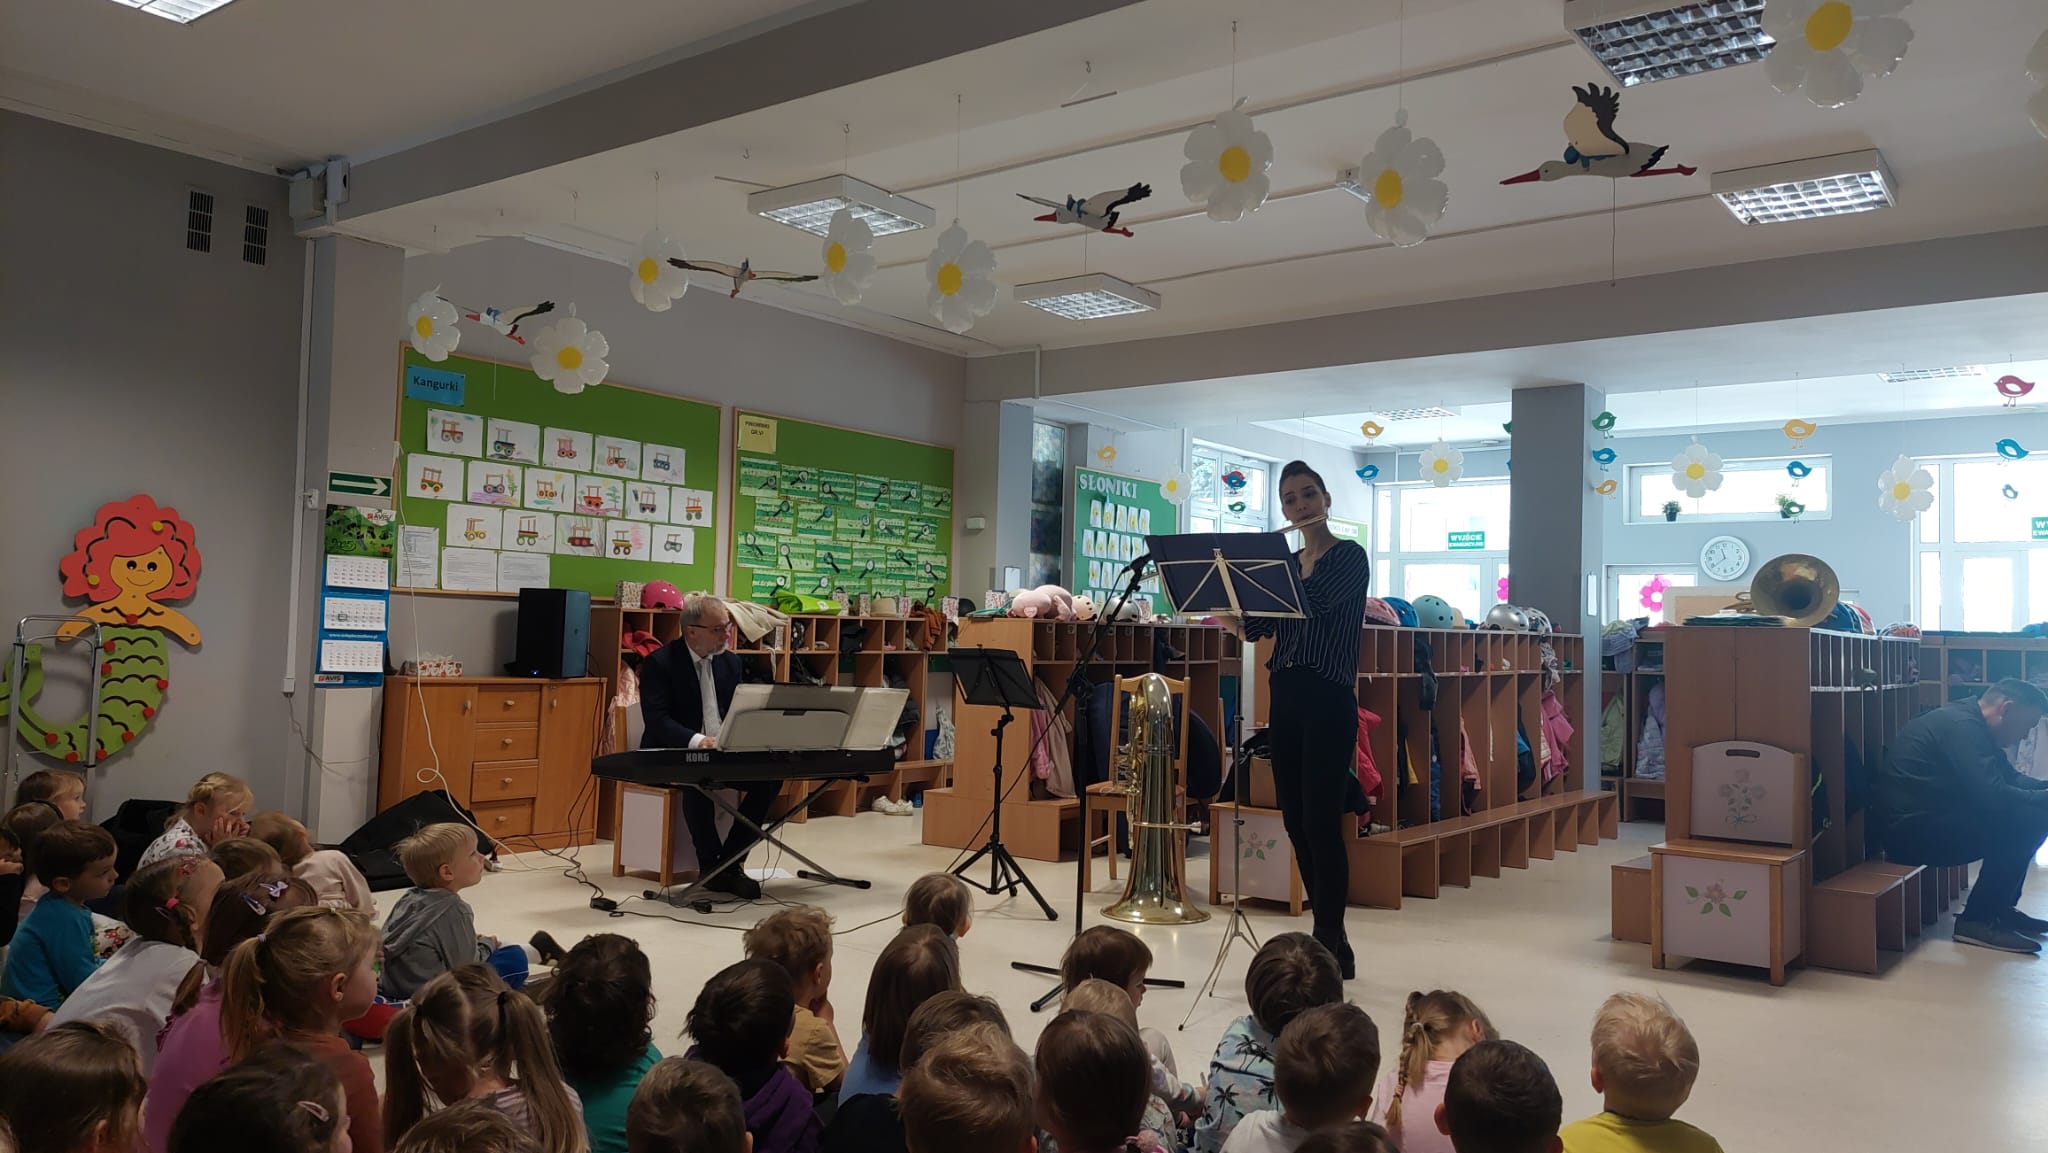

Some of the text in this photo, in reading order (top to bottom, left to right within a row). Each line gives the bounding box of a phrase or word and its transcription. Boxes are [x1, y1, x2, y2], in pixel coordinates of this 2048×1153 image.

[413, 375, 458, 391] Kangurki
[1079, 473, 1137, 499] SŁONIKI
[686, 752, 710, 763] KORG
